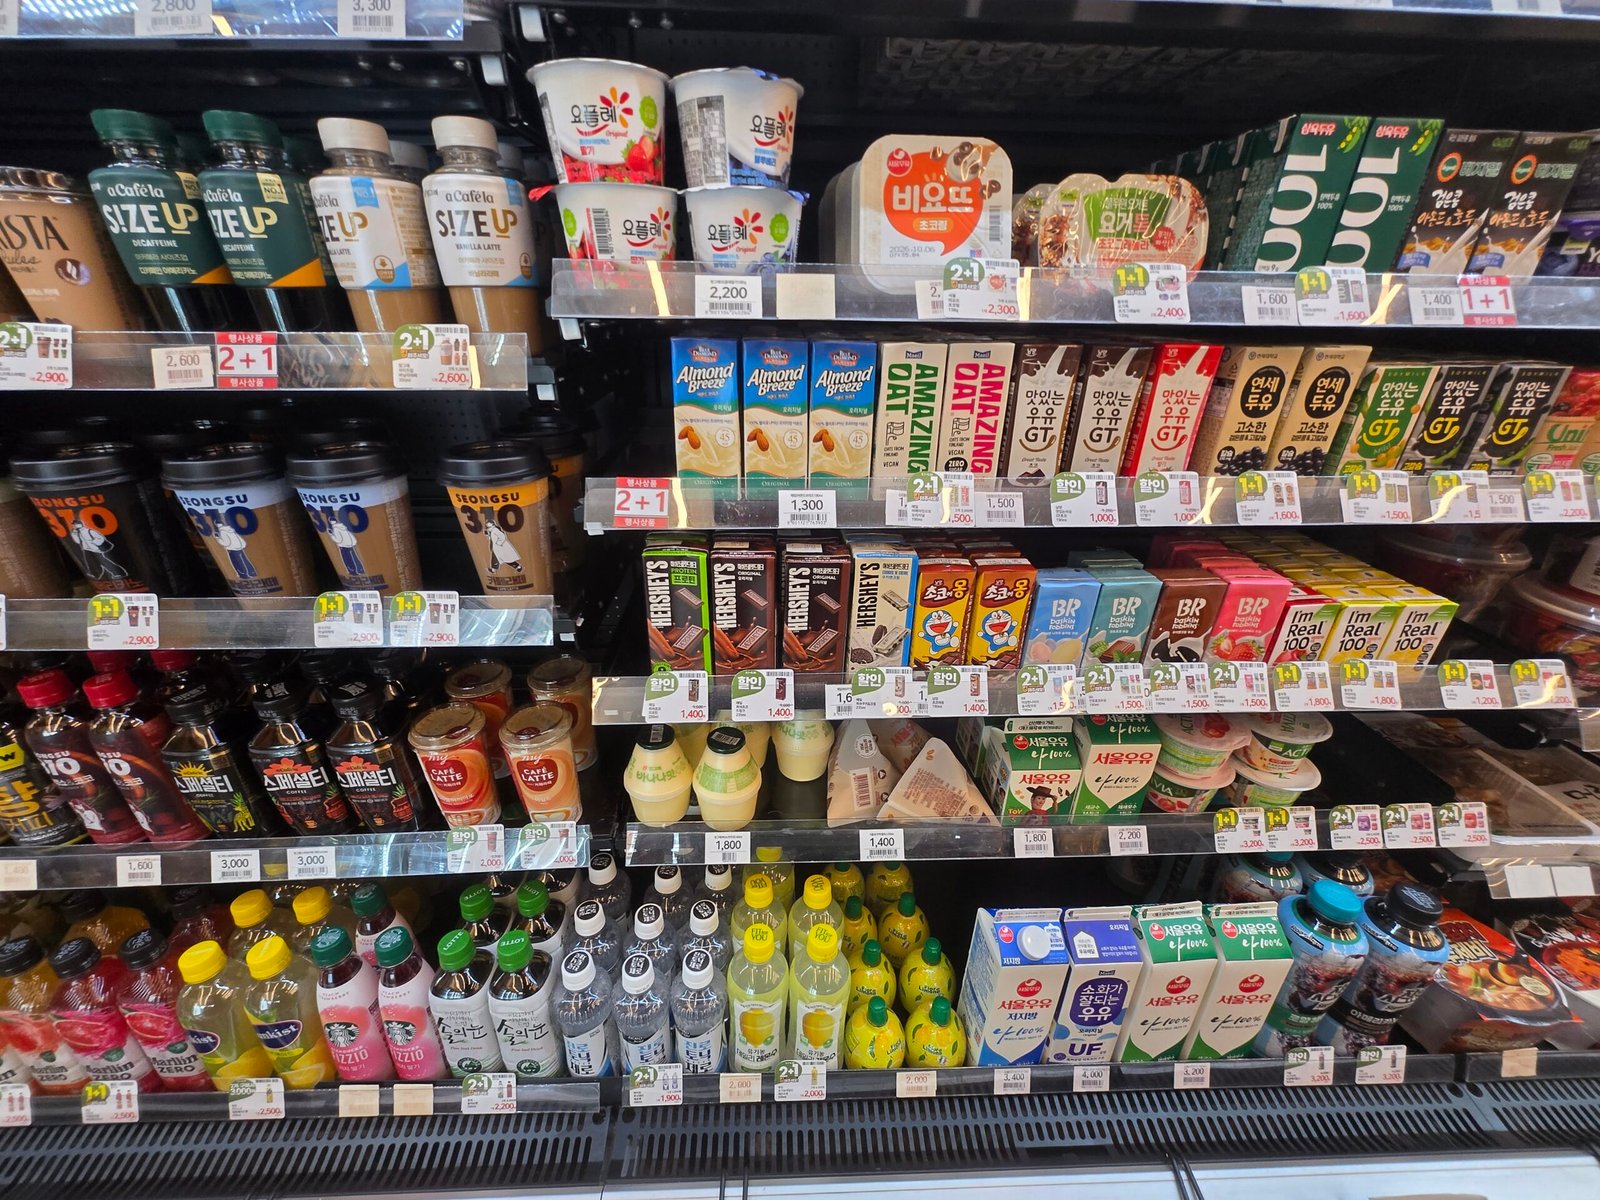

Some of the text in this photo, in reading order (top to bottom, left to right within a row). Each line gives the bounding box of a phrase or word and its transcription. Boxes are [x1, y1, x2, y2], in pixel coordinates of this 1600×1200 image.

[571, 104, 618, 124] 요플레
[750, 115, 789, 138] 요플레
[1301, 122, 1336, 136] 삼육두유
[1375, 125, 1409, 139] 삼육두유
[892, 184, 974, 214] 비요뜨
[1431, 189, 1463, 209] 검은콩
[1504, 191, 1538, 210] 검은콩
[239, 206, 278, 239] UP
[336, 211, 368, 242] UP
[491, 208, 518, 238] UP
[622, 218, 662, 241] 요플레
[919, 219, 948, 232] 초코링
[708, 225, 748, 244] 요플레
[132, 239, 178, 248] DECAFFEINE
[950, 261, 980, 281] 2+1
[1117, 268, 1146, 288] 1+1
[710, 286, 748, 300] 2,200
[1257, 293, 1288, 305] 1,600
[1423, 293, 1452, 305] 1,400
[1463, 288, 1511, 310] 1+1
[228, 334, 263, 344] 행사상품
[166, 354, 200, 368] 2,600
[219, 348, 274, 371] 2+1
[677, 363, 734, 384] Almond
[747, 365, 804, 386] Almond
[230, 378, 264, 387] 행사상품
[688, 378, 726, 393] Breeze
[758, 380, 795, 395] Breeze
[887, 363, 912, 415] OAT
[950, 363, 980, 415] OAT
[1251, 377, 1276, 393] 연세
[1316, 377, 1342, 392] 연세
[1382, 382, 1419, 398] 맛있는
[1443, 381, 1479, 398] 맛있는
[1515, 381, 1550, 398] 맛있는
[1025, 390, 1065, 407] 맛있는
[1093, 390, 1131, 407] 맛있는
[1162, 390, 1200, 406] 맛있는
[1245, 394, 1272, 410] 두유
[1309, 395, 1336, 410] 두유
[783, 406, 801, 414] 오리지널
[849, 407, 868, 415] 오리지널
[1376, 399, 1405, 416] 두유
[1438, 399, 1466, 415] 두유
[1508, 399, 1536, 416] 두유
[908, 363, 939, 473] AMAZING
[971, 363, 1006, 473] AMAZING
[1026, 408, 1055, 425] 우유
[1092, 408, 1122, 425] 우유
[1160, 408, 1189, 424] 우유
[1234, 422, 1267, 434] 고소한
[1297, 422, 1329, 434] 고소한
[1367, 419, 1392, 437] GT
[1428, 417, 1453, 435] GT
[1498, 418, 1523, 435] GT
[1024, 427, 1054, 443] GT
[1089, 427, 1118, 443] GT
[1157, 426, 1186, 442] GT
[627, 479, 657, 487] 행사상품
[1056, 480, 1082, 495] 할인
[1354, 475, 1377, 491] 1+1
[456, 492, 520, 504] SEONGSU
[616, 490, 665, 511] 2+1
[791, 500, 823, 511] 1,300
[987, 498, 1015, 509] 1,500
[1489, 495, 1514, 504] 1,500
[625, 518, 655, 526] 행사상품
[646, 561, 672, 628] HERSHEY'S
[714, 563, 737, 629] HERSHEY'S
[787, 567, 811, 632] HERSHEY'S
[856, 563, 881, 628] HERSHEY'S
[92, 600, 119, 617] 1+1
[396, 596, 421, 613] 1+1
[1052, 599, 1079, 617] BR
[1112, 597, 1141, 616] BR
[1050, 618, 1076, 626] baskin
[1291, 611, 1312, 623] I'm
[1348, 611, 1371, 623] I'm
[1049, 623, 1075, 631] robbins
[1287, 622, 1323, 637] Real
[1343, 622, 1380, 637] Real
[1283, 637, 1309, 652] 100
[1338, 637, 1365, 652] 100
[1020, 670, 1043, 686] 2+1
[1154, 669, 1177, 685] 2+1
[1345, 664, 1365, 679] 1+1
[1515, 666, 1537, 681] 1+1
[650, 678, 675, 692] 할인
[858, 675, 882, 688] 할인
[1028, 736, 1068, 748] 서울우유
[1093, 752, 1153, 765] 서울우유
[265, 769, 329, 791] 스페셜티
[337, 768, 397, 789] 스페셜티
[431, 773, 463, 783] LATTE
[521, 773, 554, 782] LATTE
[1018, 772, 1070, 785] 서울우유
[1267, 811, 1287, 825] 1+1
[1387, 808, 1406, 822] 2+1
[453, 830, 475, 844] 할인
[869, 836, 895, 847] 1,400
[1025, 833, 1047, 842] 1,800
[1118, 830, 1141, 839] 2,200
[716, 839, 741, 850] 1,800
[129, 861, 153, 871] 1,600
[222, 858, 249, 869] 3,000
[298, 854, 325, 866] 3,000
[1164, 924, 1201, 937] 서울우유
[1238, 923, 1277, 936] 서울우유
[443, 931, 464, 951] LOTTE
[500, 937, 526, 947] LOTTE
[1003, 957, 1021, 965] 저지방
[1080, 984, 1123, 995] 소화가
[998, 999, 1052, 1010] 서울우유
[1079, 995, 1121, 1007] 잘되는
[1146, 993, 1199, 1007] 서울우유
[1220, 993, 1272, 1005] 서울우유
[1007, 1012, 1037, 1021] 저지방
[1078, 1007, 1112, 1022] 우유
[438, 1016, 488, 1045] 솔의눈
[497, 1017, 550, 1046] 솔의눈
[1069, 1043, 1103, 1056] UF
[158, 1063, 195, 1073] ZERO
[779, 1067, 799, 1078] 2+1
[1082, 1070, 1103, 1079] 4,000
[1184, 1067, 1204, 1075] 3,200
[468, 1077, 488, 1091] 2+1
[729, 1080, 751, 1088] 2,000
[1003, 1072, 1024, 1081] 3,400
